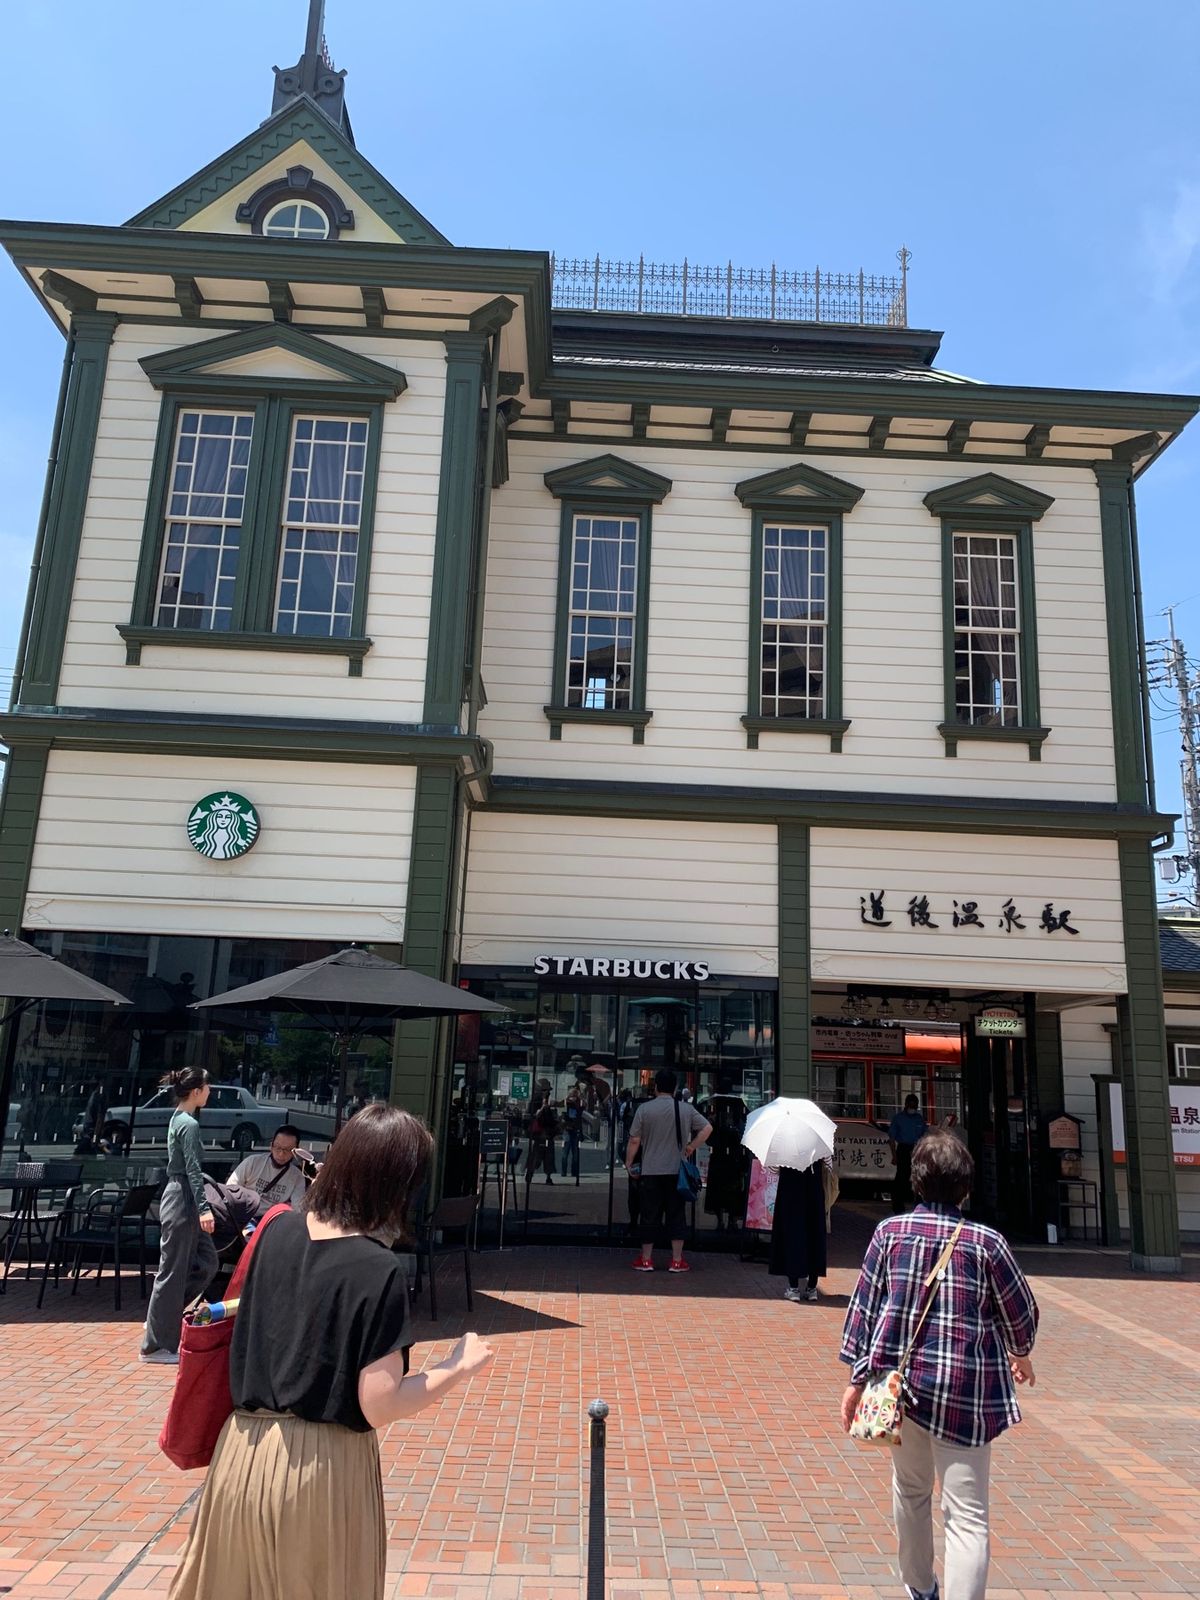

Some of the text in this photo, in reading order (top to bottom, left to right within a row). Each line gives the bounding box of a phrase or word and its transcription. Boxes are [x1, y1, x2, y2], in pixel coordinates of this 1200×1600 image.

[860, 889, 1079, 935] 道後温泉駅
[534, 955, 709, 981] STARBUCKS
[978, 1019, 1023, 1028] チケットカウンター
